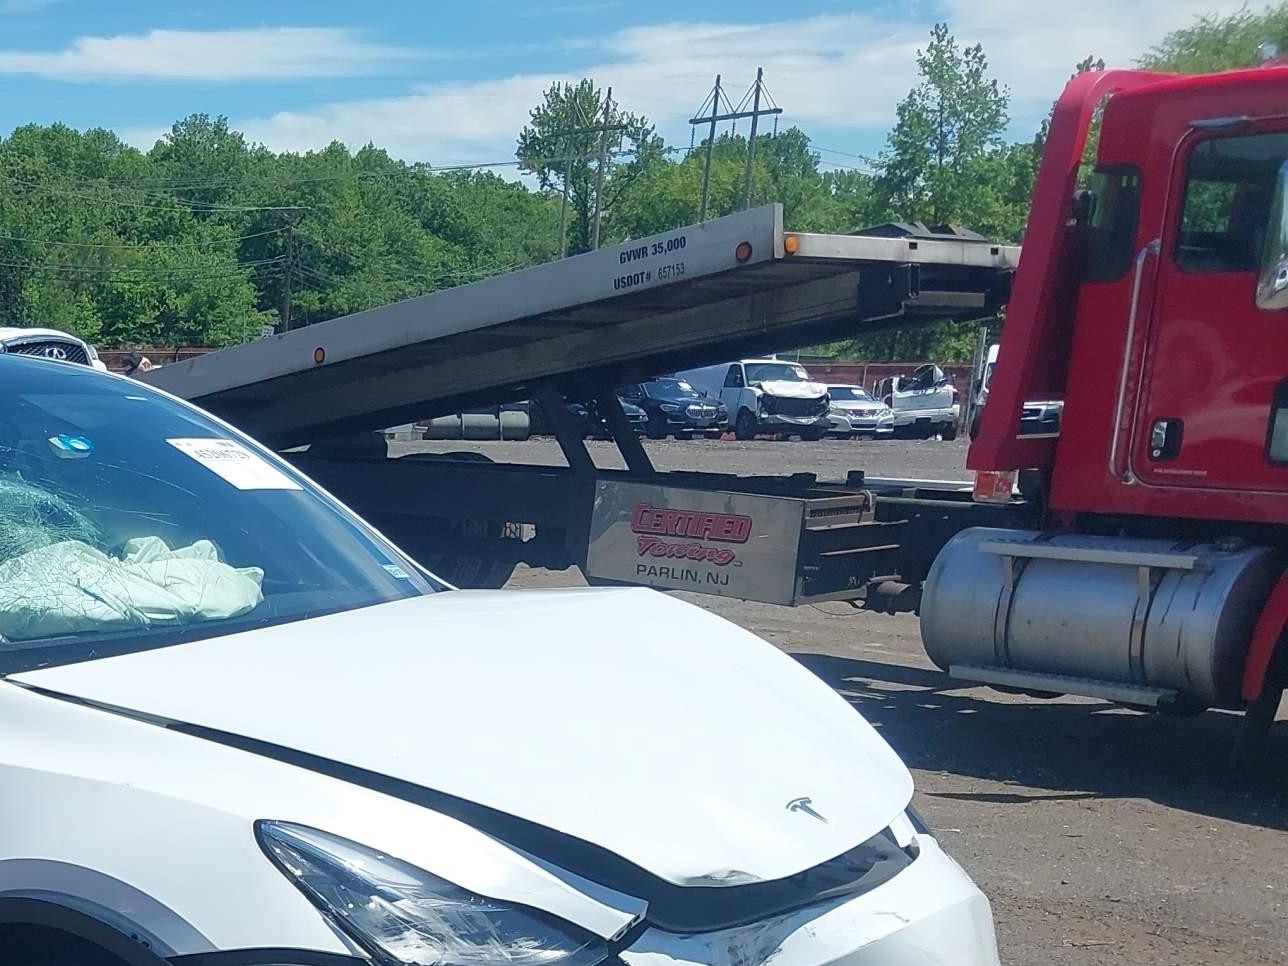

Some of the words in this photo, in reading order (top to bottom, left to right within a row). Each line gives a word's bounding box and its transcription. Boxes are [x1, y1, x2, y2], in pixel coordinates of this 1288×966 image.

[619, 243, 649, 264] GVWR
[651, 236, 687, 256] 35,000
[613, 271, 651, 290] USDOT#
[658, 263, 685, 280] 657153
[631, 504, 753, 544] CERTIFIED
[637, 535, 735, 566] Towing
[636, 564, 702, 584] PARLIN,
[707, 571, 730, 586] NJ
